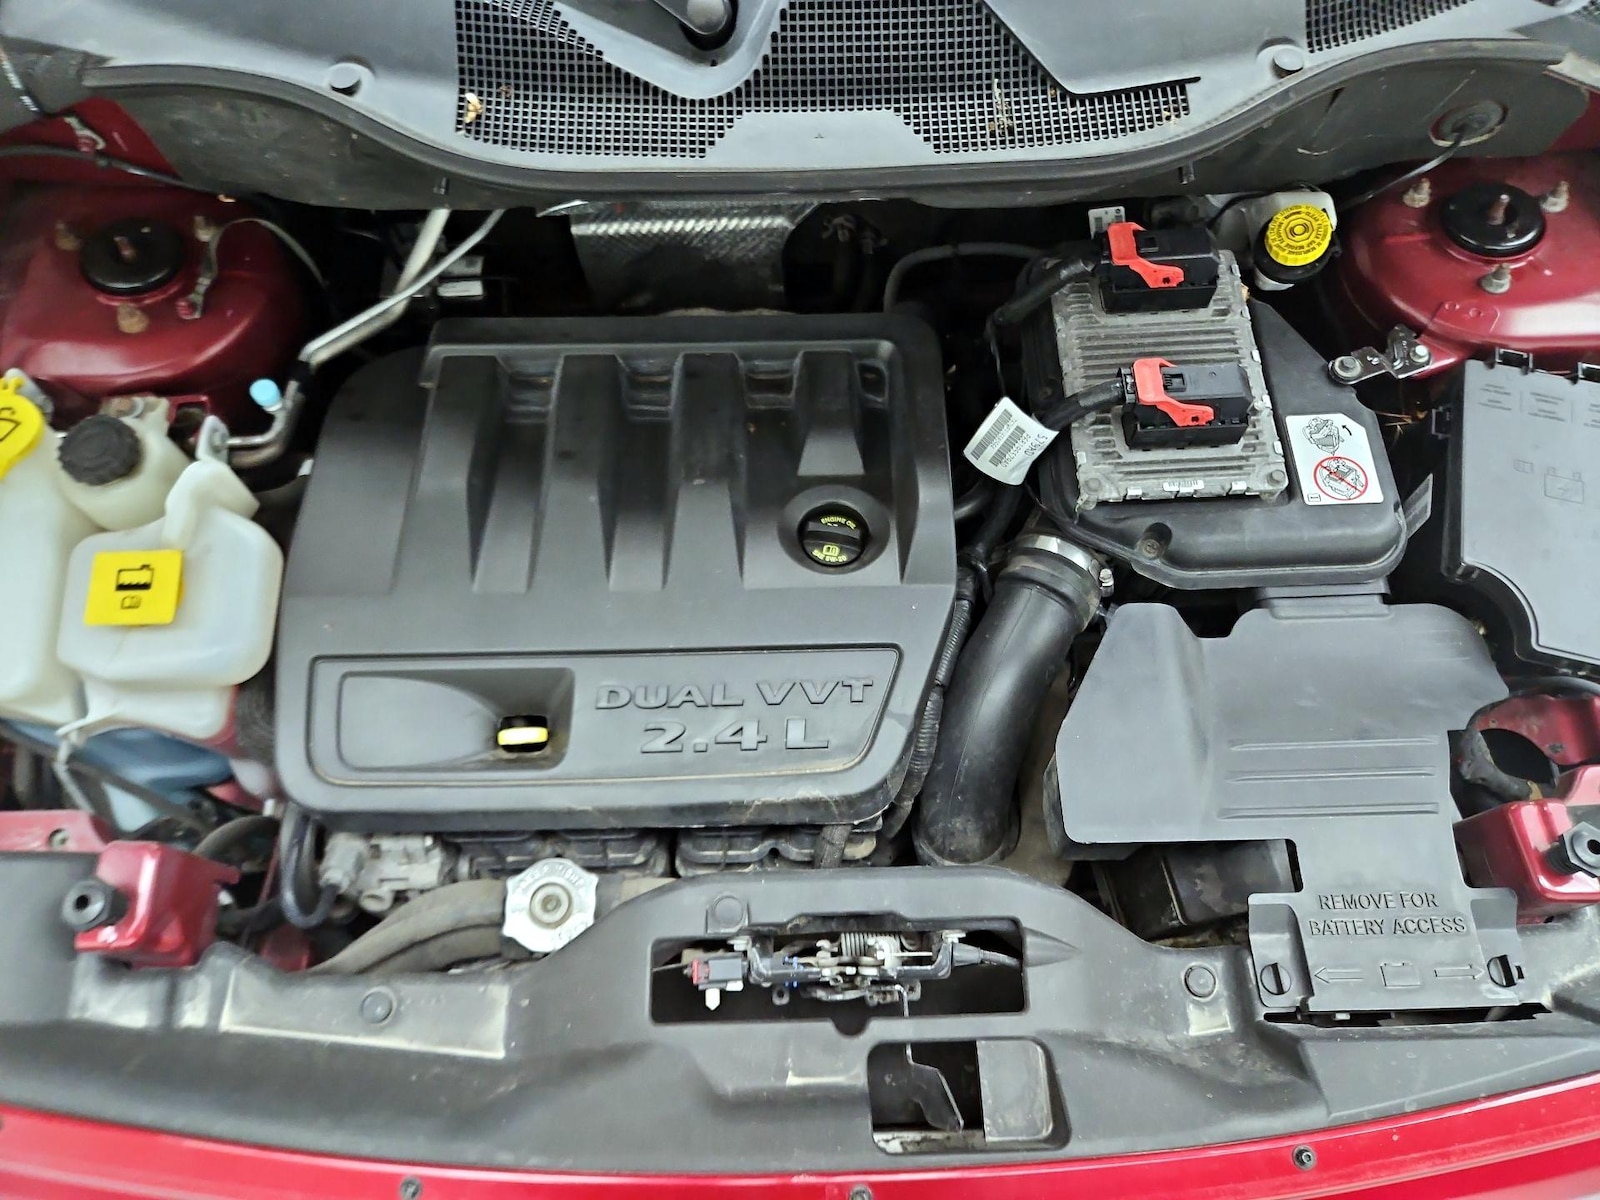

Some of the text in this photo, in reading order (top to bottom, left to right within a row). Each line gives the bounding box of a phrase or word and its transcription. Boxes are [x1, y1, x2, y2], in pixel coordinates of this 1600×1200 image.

[595, 677, 874, 710] DUAL VVT
[640, 716, 830, 754] 2.4 L
[1317, 891, 1440, 911] REMOVE FOR
[1308, 916, 1468, 936] BATTERY ACCESS
